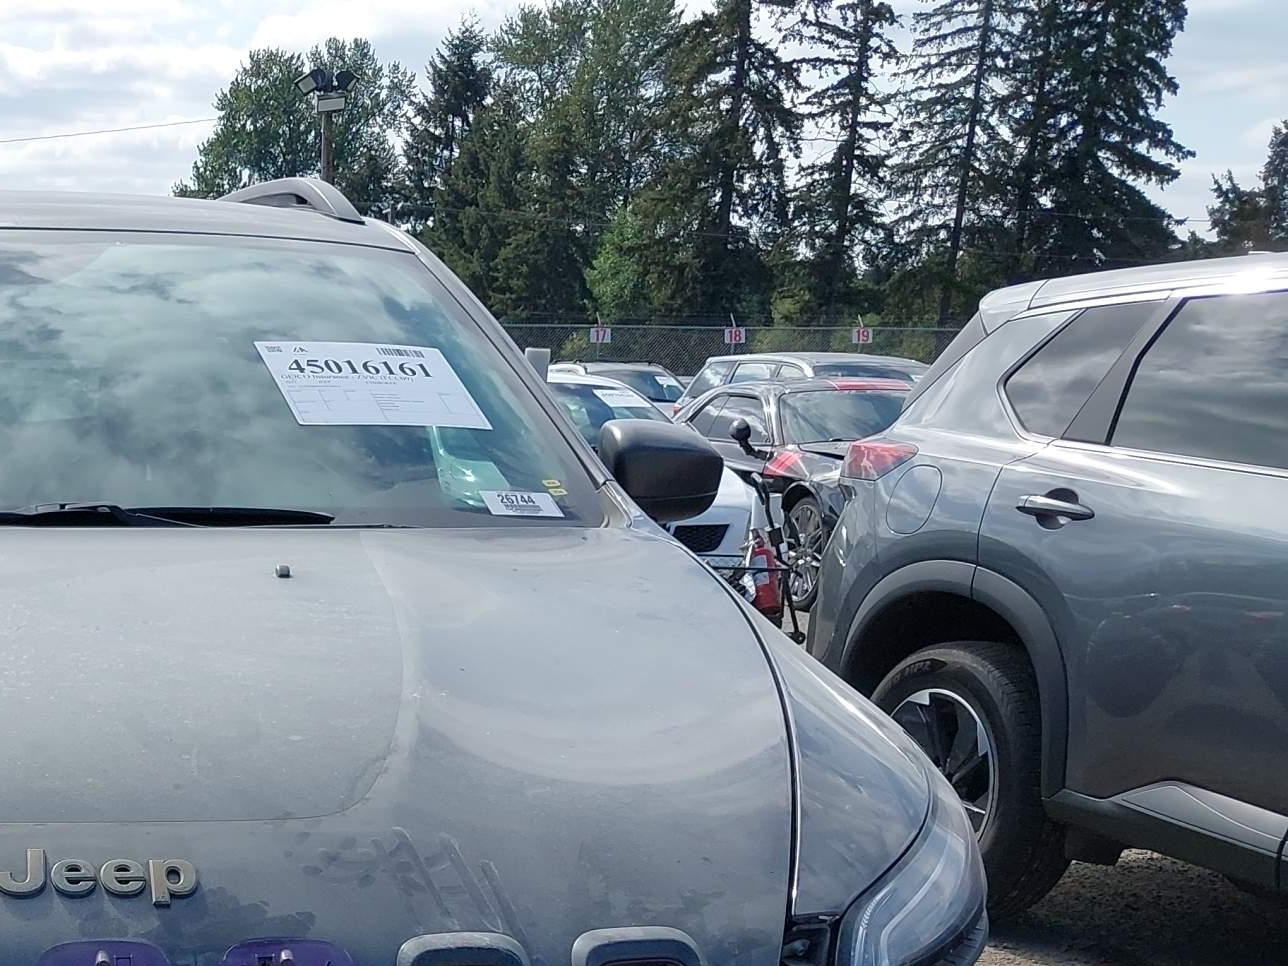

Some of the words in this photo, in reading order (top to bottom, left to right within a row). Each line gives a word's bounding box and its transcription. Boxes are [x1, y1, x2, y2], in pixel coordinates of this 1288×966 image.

[595, 328, 607, 342] 17
[728, 329, 742, 342] 18
[856, 329, 869, 342] 19
[288, 359, 433, 378] 45016161
[497, 494, 536, 505] 26744
